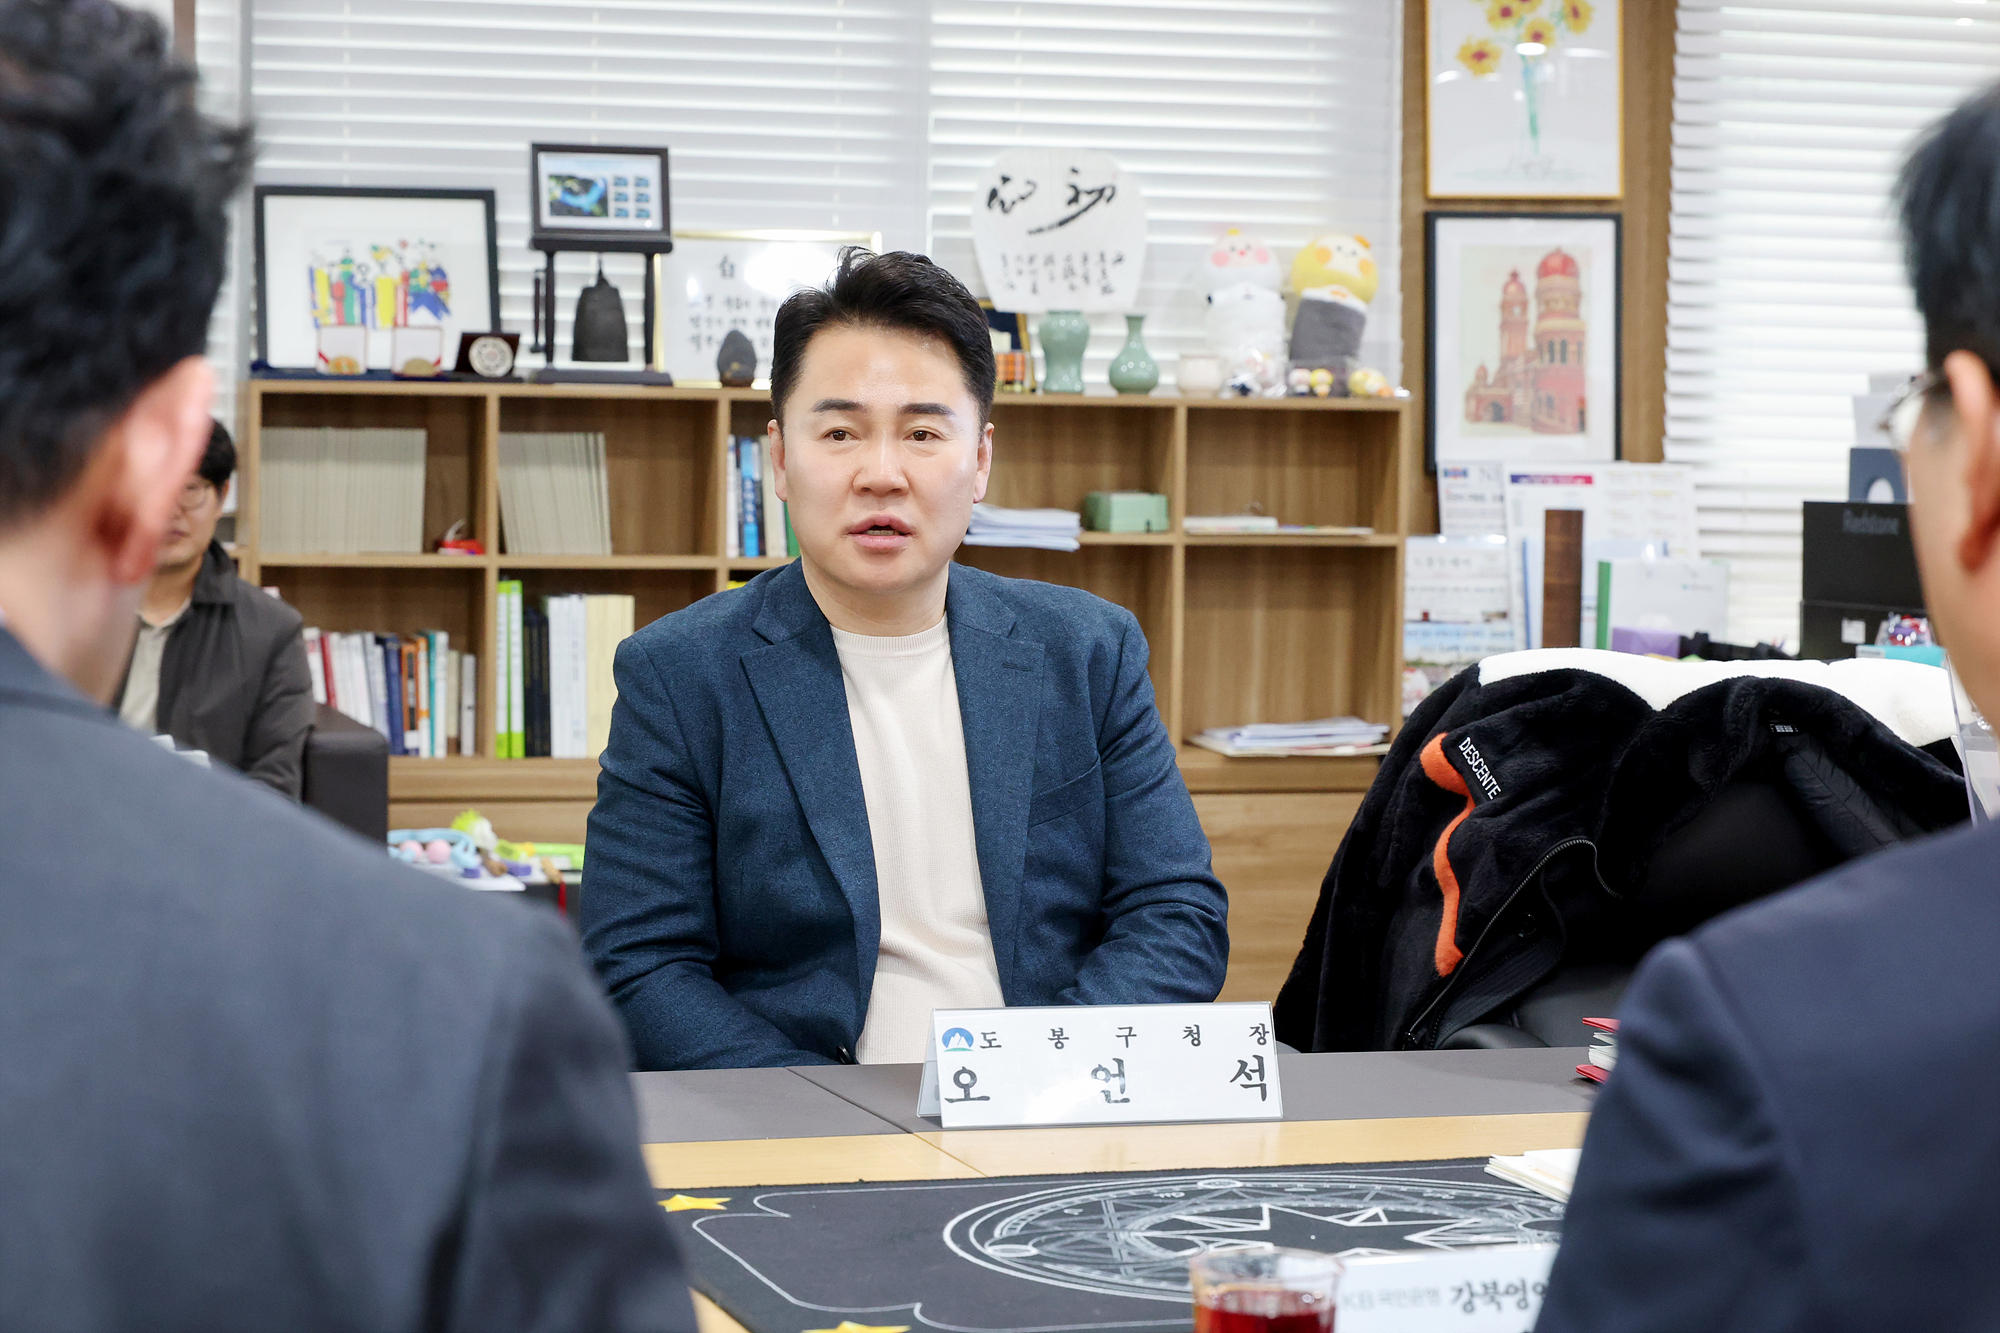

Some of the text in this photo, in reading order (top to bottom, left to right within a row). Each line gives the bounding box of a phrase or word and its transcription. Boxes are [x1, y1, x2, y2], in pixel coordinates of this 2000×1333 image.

[1458, 736, 1502, 800] DESCENTE
[979, 1022, 1270, 1050] 도 봉 구 청 장
[944, 1054, 1268, 1104] 오 언 석
